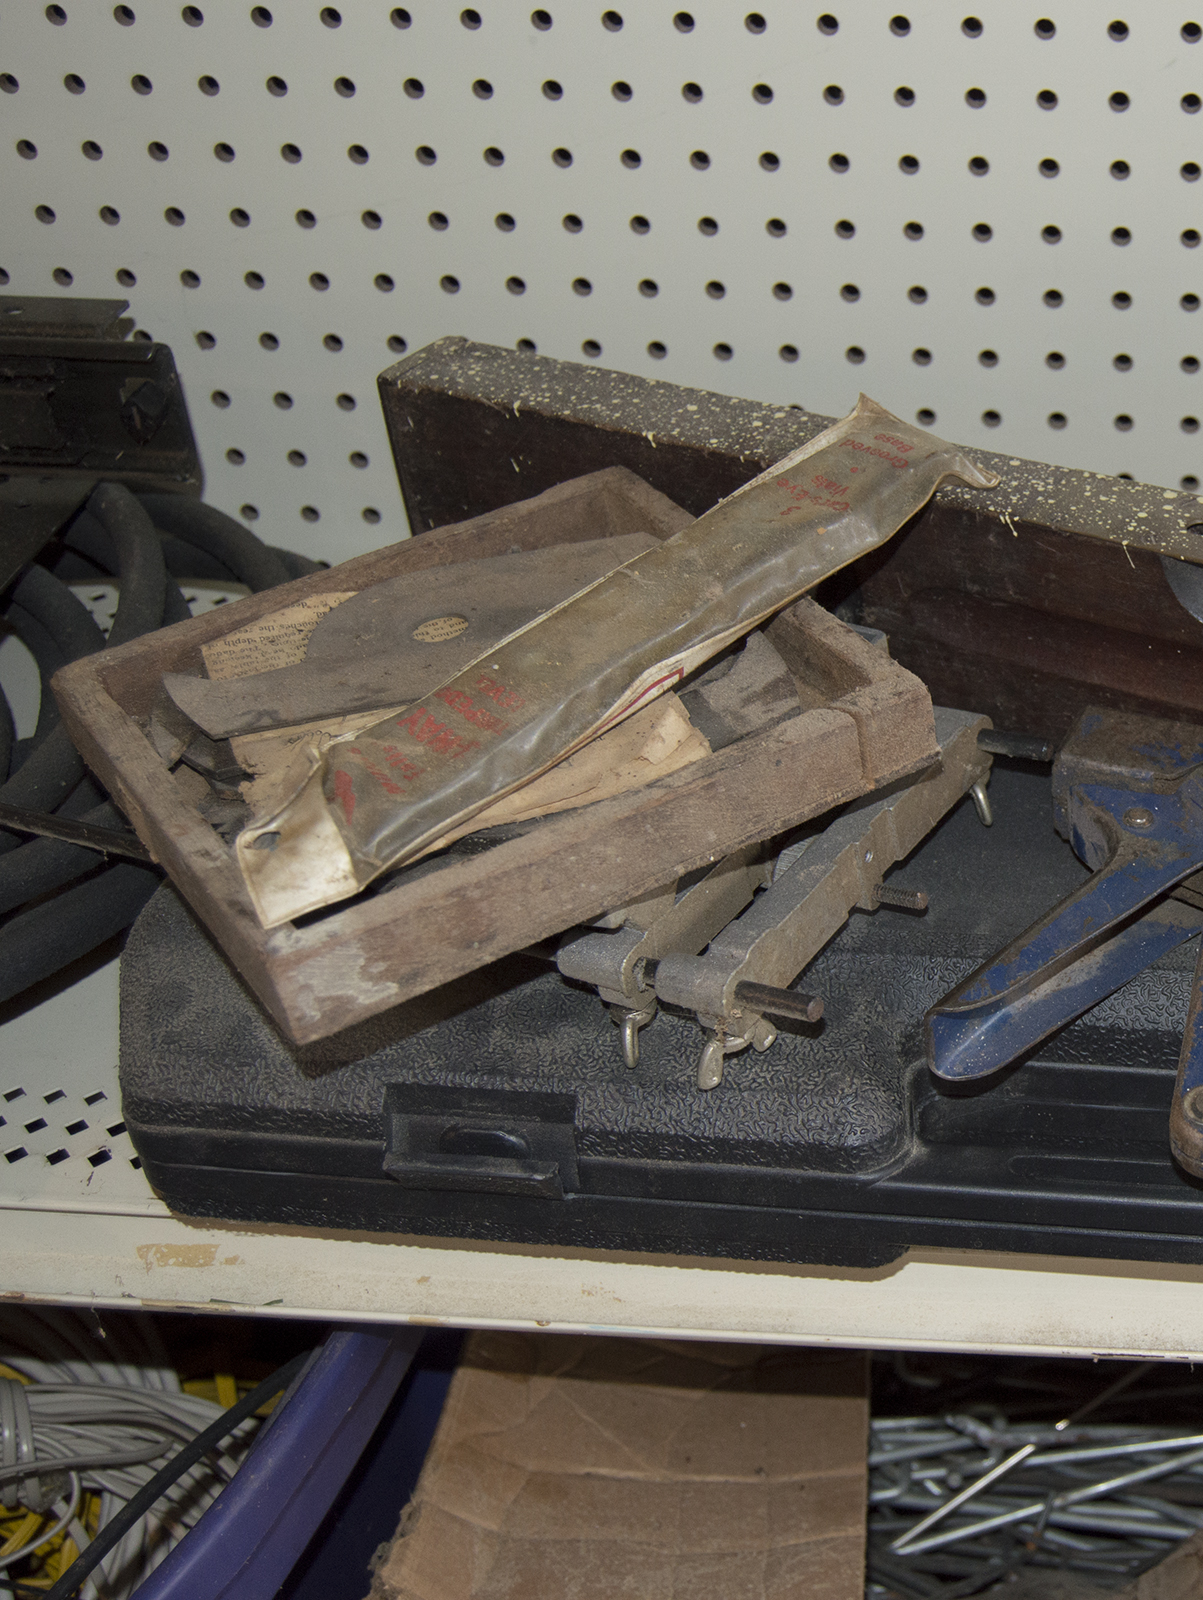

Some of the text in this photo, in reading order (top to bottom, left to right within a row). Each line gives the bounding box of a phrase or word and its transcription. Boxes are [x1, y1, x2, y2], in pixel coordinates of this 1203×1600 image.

[875, 434, 914, 453] Base
[839, 439, 908, 469] Grooved
[258, 625, 275, 633] the
[223, 637, 253, 647] depth
